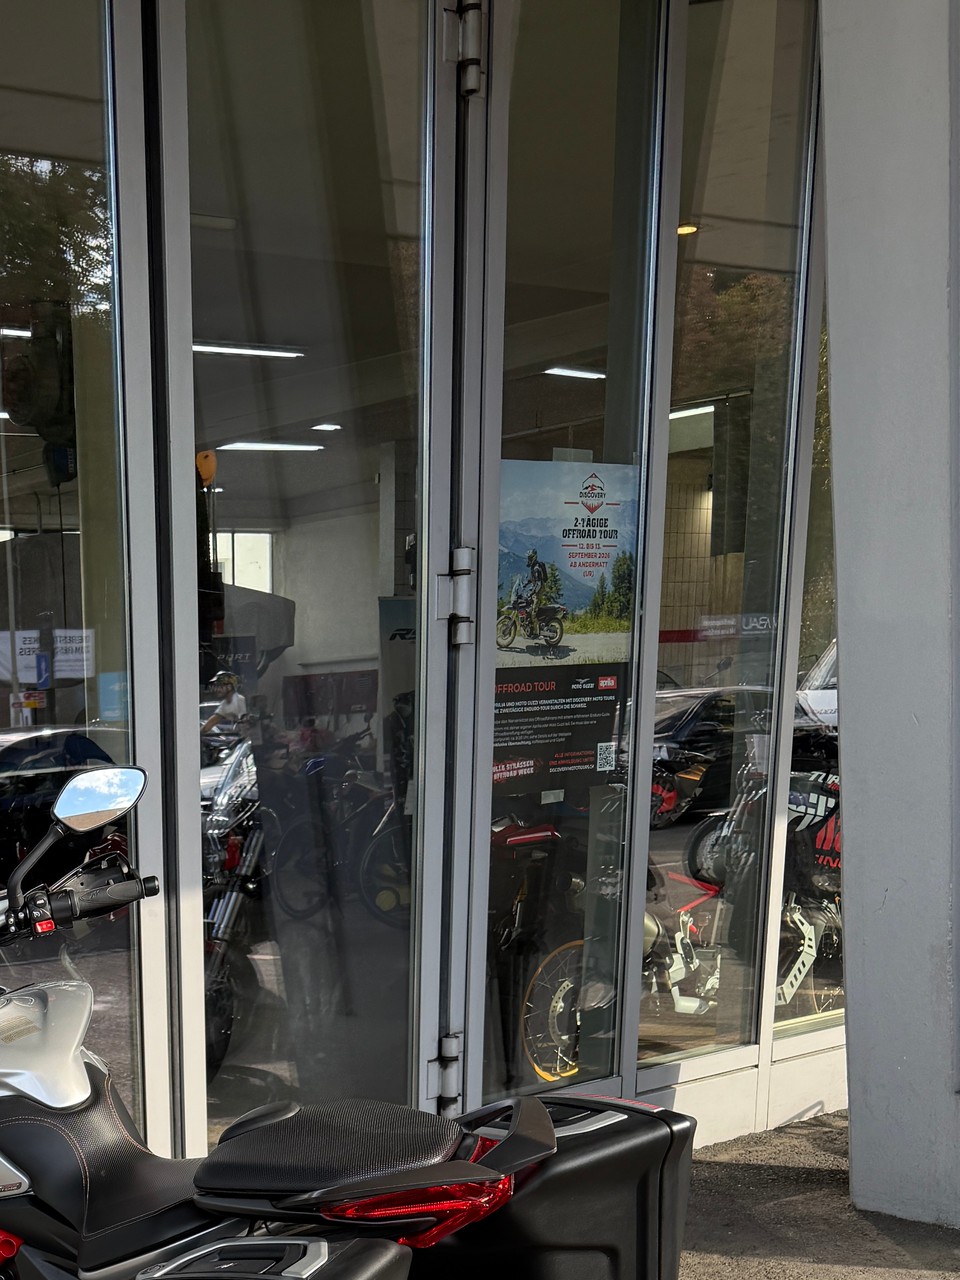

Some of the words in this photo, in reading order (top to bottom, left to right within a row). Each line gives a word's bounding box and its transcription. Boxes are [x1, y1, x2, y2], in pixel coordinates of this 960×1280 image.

[574, 515, 609, 528] 2-TÄGIGE
[562, 529, 597, 539] OFFROAD
[599, 529, 618, 539] TOUR
[534, 681, 556, 692] TOUR
